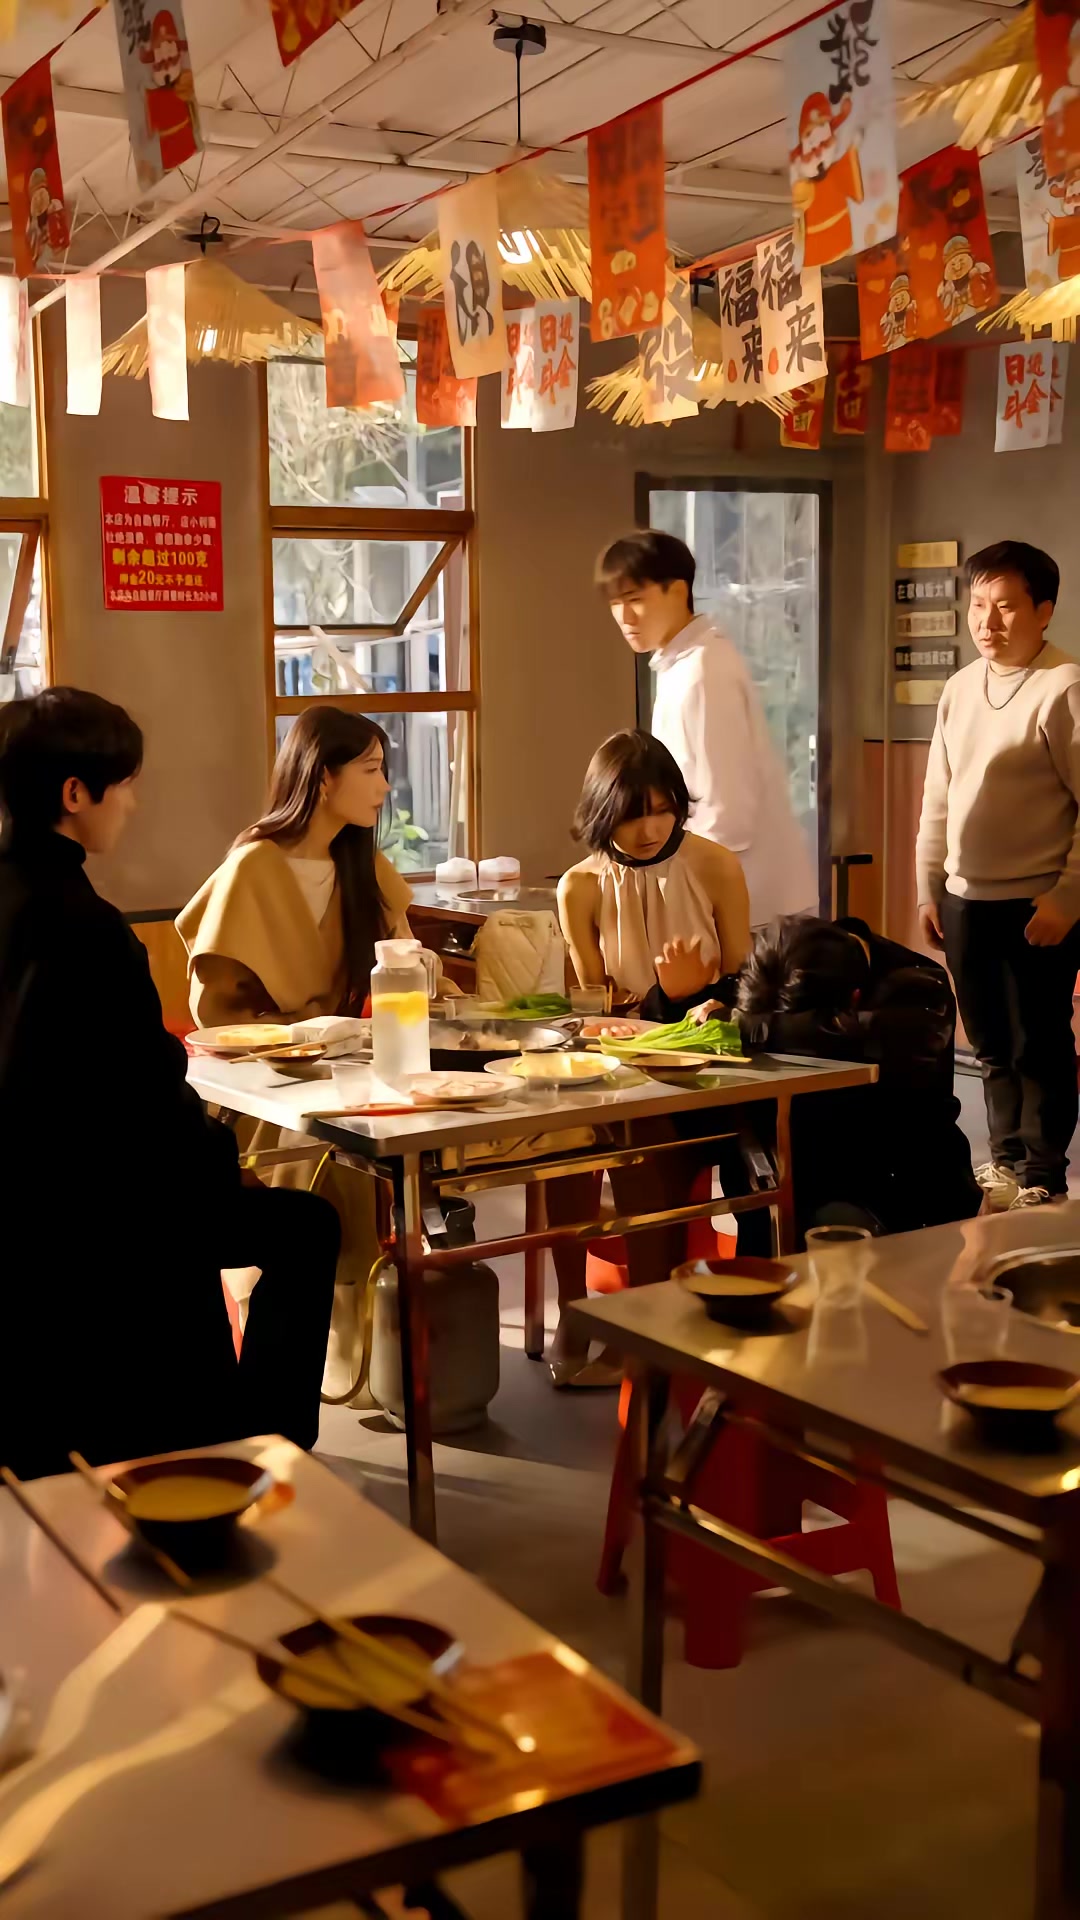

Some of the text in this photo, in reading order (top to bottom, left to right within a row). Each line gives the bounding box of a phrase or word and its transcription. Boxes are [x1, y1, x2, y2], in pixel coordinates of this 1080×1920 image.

[720, 258, 764, 384] 福来
[760, 231, 823, 374] 福来
[124, 484, 198, 506] 温馨提示
[112, 548, 208, 568] 剩余超过100克
